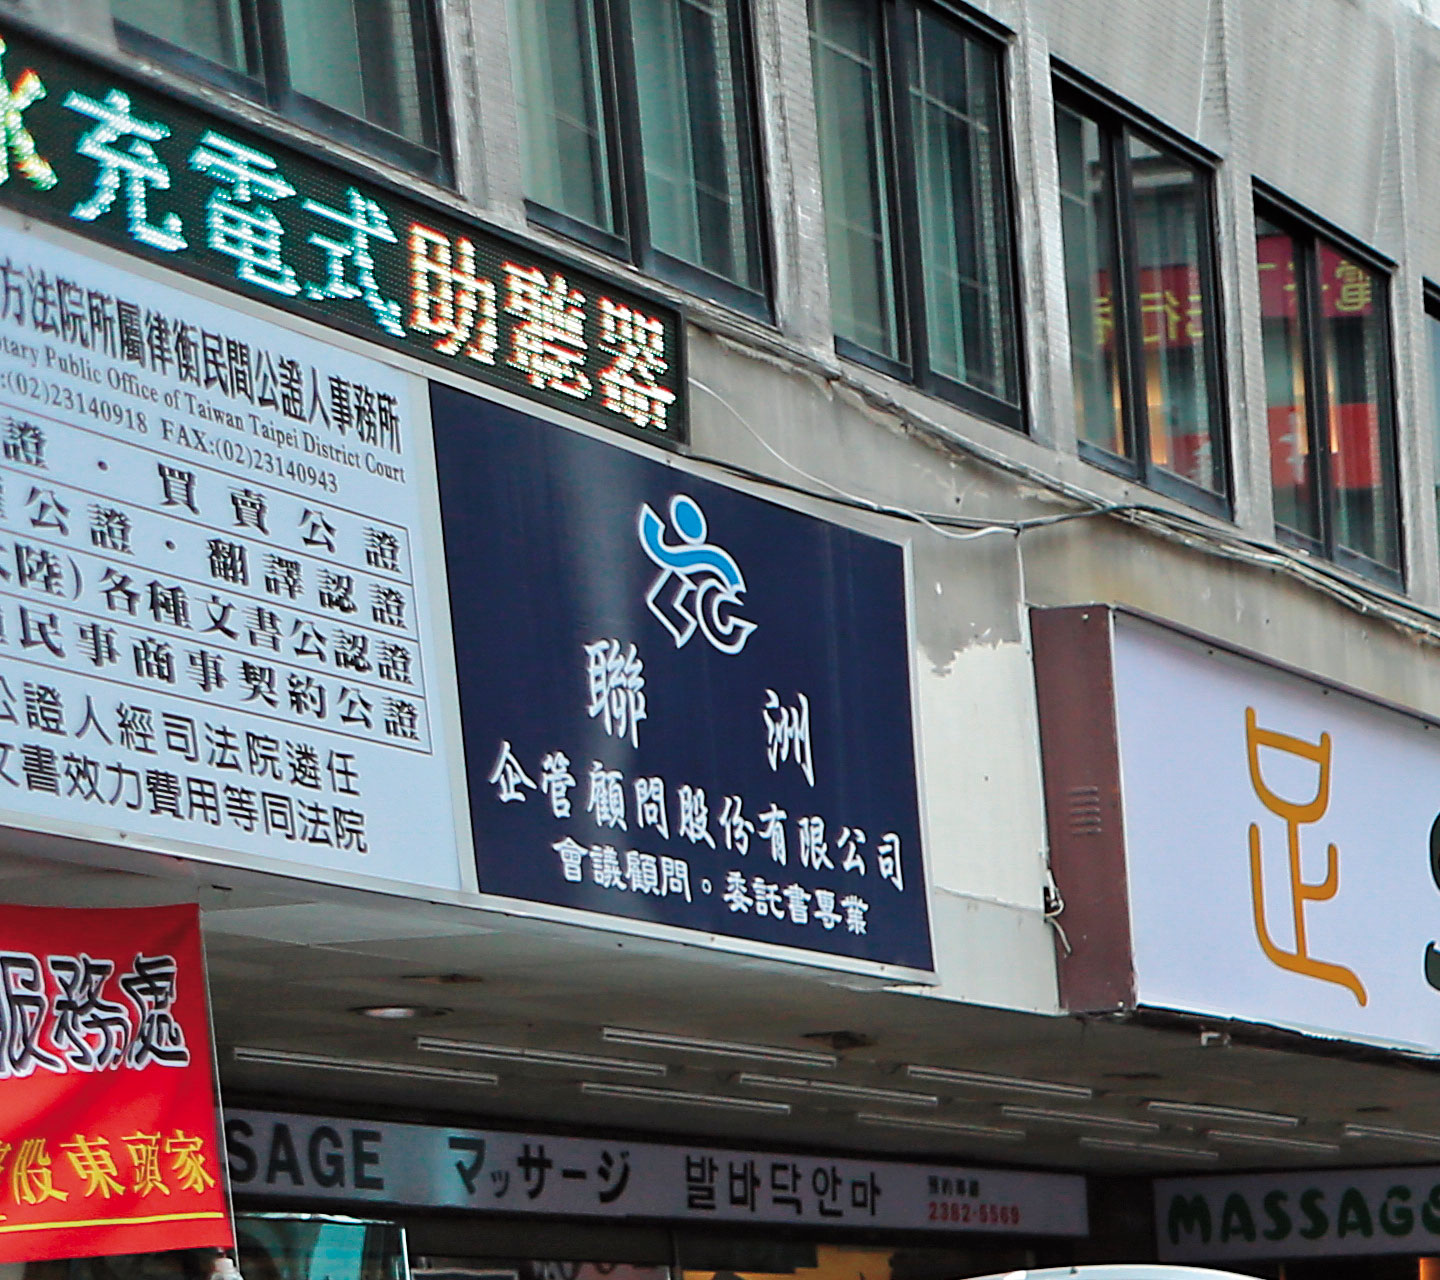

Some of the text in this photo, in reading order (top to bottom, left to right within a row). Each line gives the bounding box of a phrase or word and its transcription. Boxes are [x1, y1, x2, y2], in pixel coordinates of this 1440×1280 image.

[46, 347, 101, 384] Public
[107, 367, 158, 401] Office
[164, 388, 184, 408] of
[184, 395, 243, 433] Taiwan
[250, 415, 299, 452] Taipei
[303, 431, 361, 470] District
[365, 453, 406, 484] Court
[161, 417, 339, 494] FAX:(02)23140943
[0, 605, 421, 741] 民事商事契約公證
[488, 740, 904, 891] 企管顧問股份有限公司
[0, 1128, 216, 1207] 股東頭家
[446, 1134, 631, 1202] マッサージ
[684, 1152, 882, 1218] 발바닥안마
